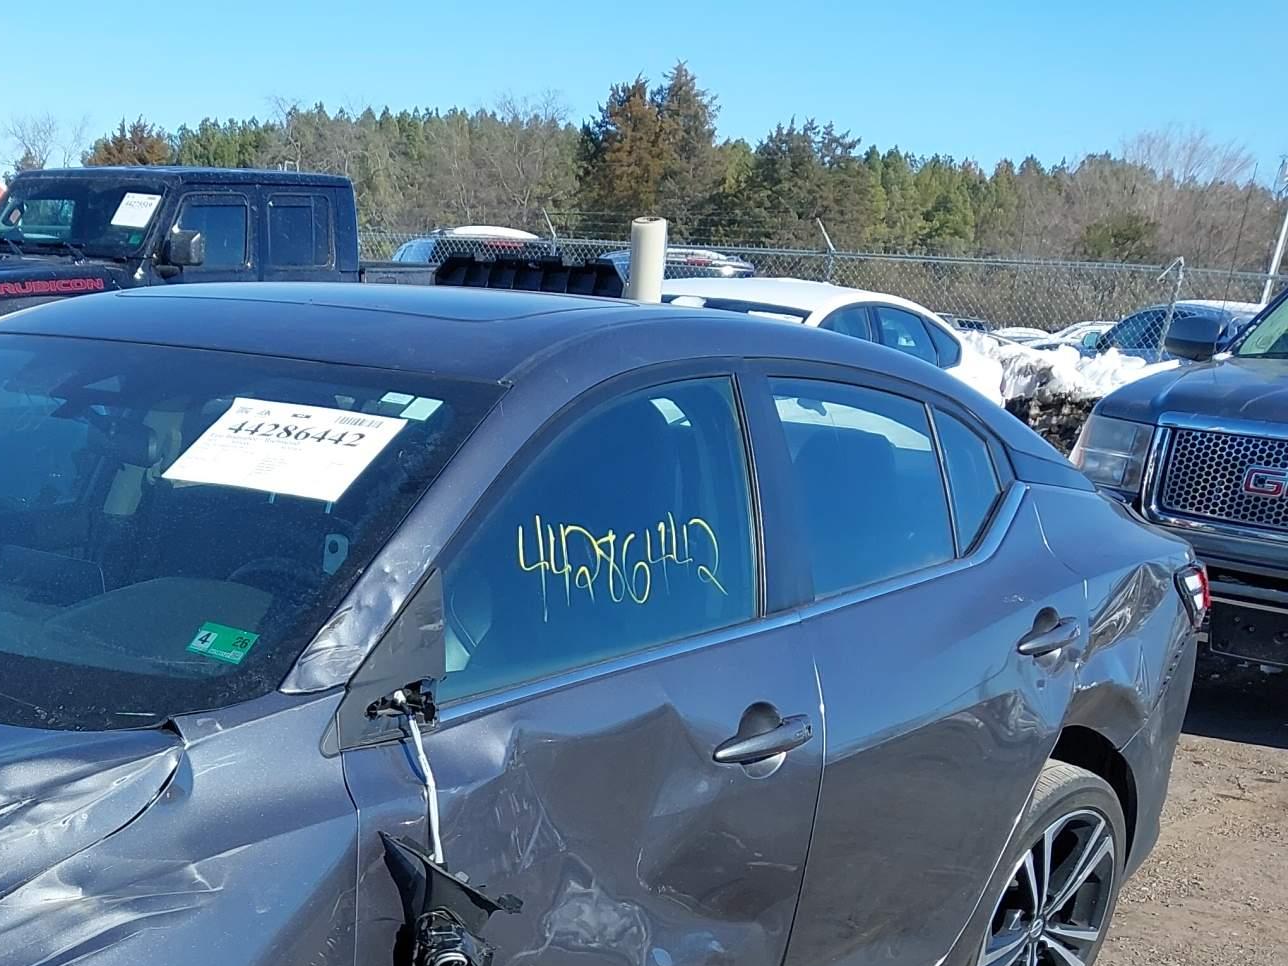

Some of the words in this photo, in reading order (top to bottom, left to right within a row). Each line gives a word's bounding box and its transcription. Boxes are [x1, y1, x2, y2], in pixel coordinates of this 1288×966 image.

[228, 420, 366, 447] 44286442
[1243, 467, 1288, 499] G
[517, 511, 729, 623] 44286442
[198, 632, 212, 645] 4
[232, 636, 250, 649] 26
